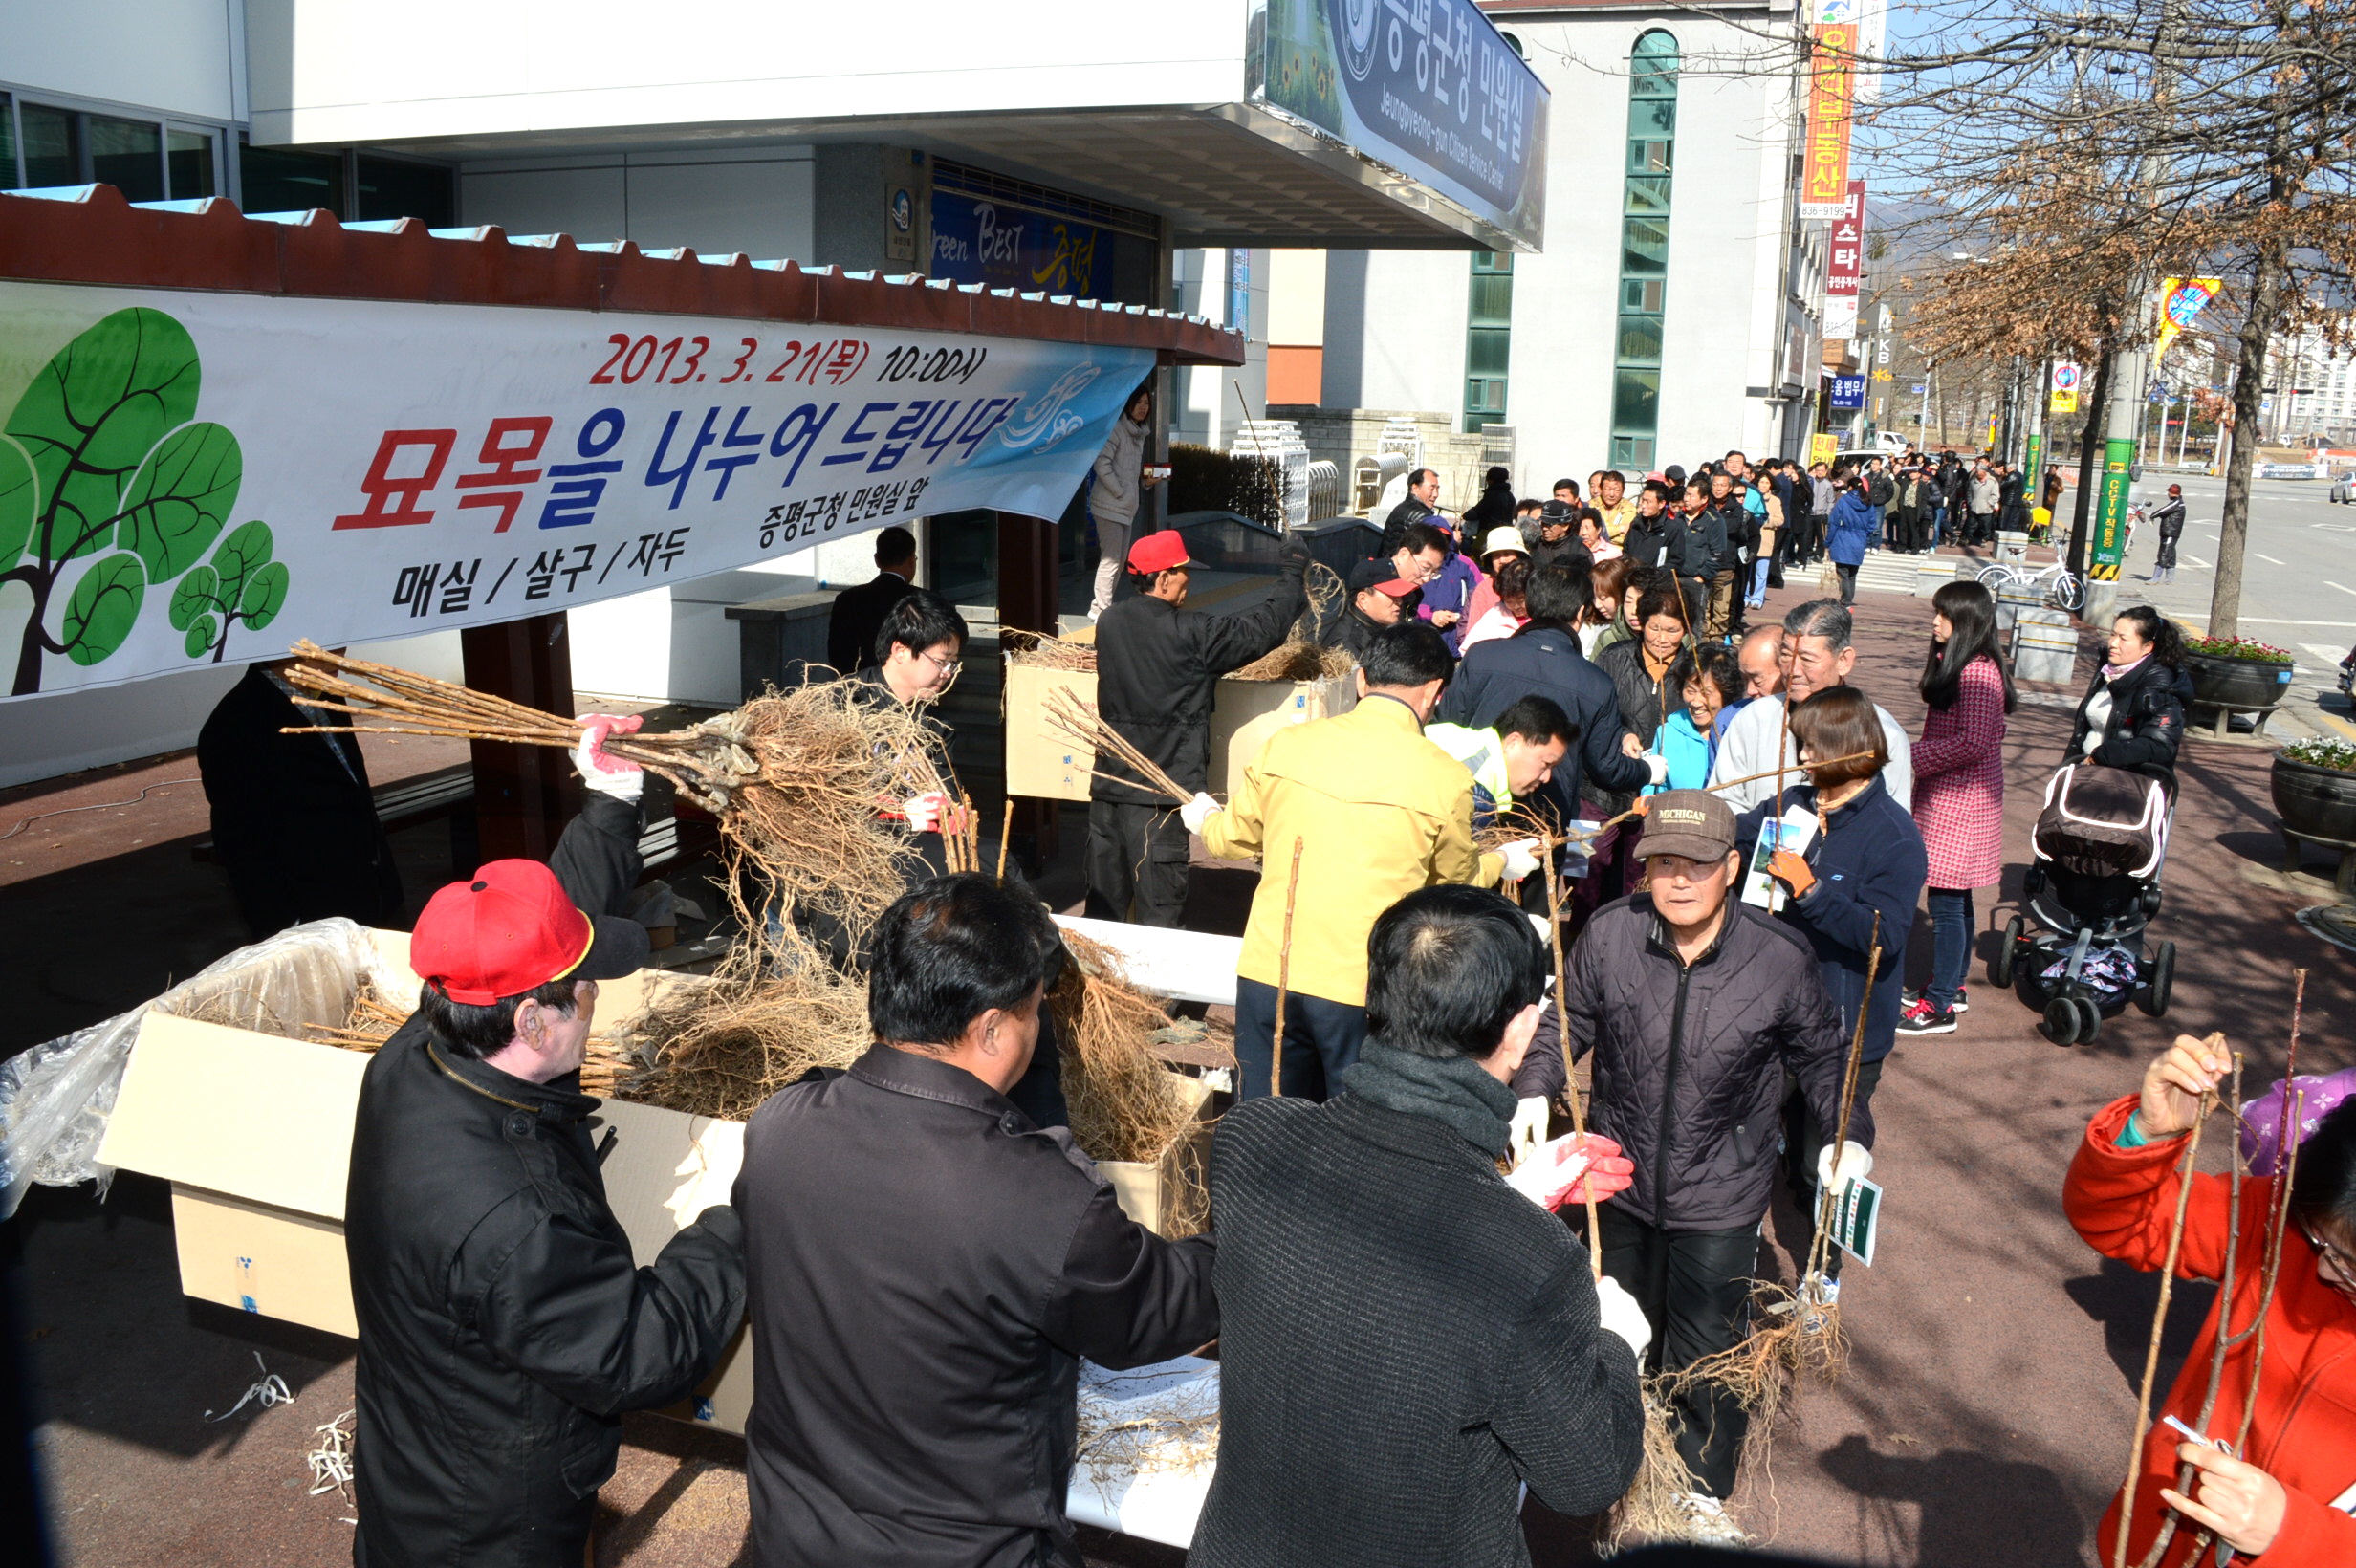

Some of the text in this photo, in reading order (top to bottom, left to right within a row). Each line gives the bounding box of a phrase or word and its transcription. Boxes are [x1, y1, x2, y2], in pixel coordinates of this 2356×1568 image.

[1380, 82, 1448, 154] Jeungpyeong-gun
[1448, 130, 1469, 168] Citizen
[1479, 40, 1525, 165] 민원실
[1811, 30, 1847, 197] 우리부동산
[931, 229, 968, 262] reen
[1801, 206, 1845, 216] 836-9199
[589, 333, 988, 386] 2013. 3. 21(목) 10:00시
[332, 397, 1017, 534] 묘목을 나누어 드립니다
[759, 476, 930, 549] 증평군청 민원실 앞
[392, 526, 691, 618] 매실 / 살구 / 자두
[1658, 809, 1706, 822] MICHIGAN
